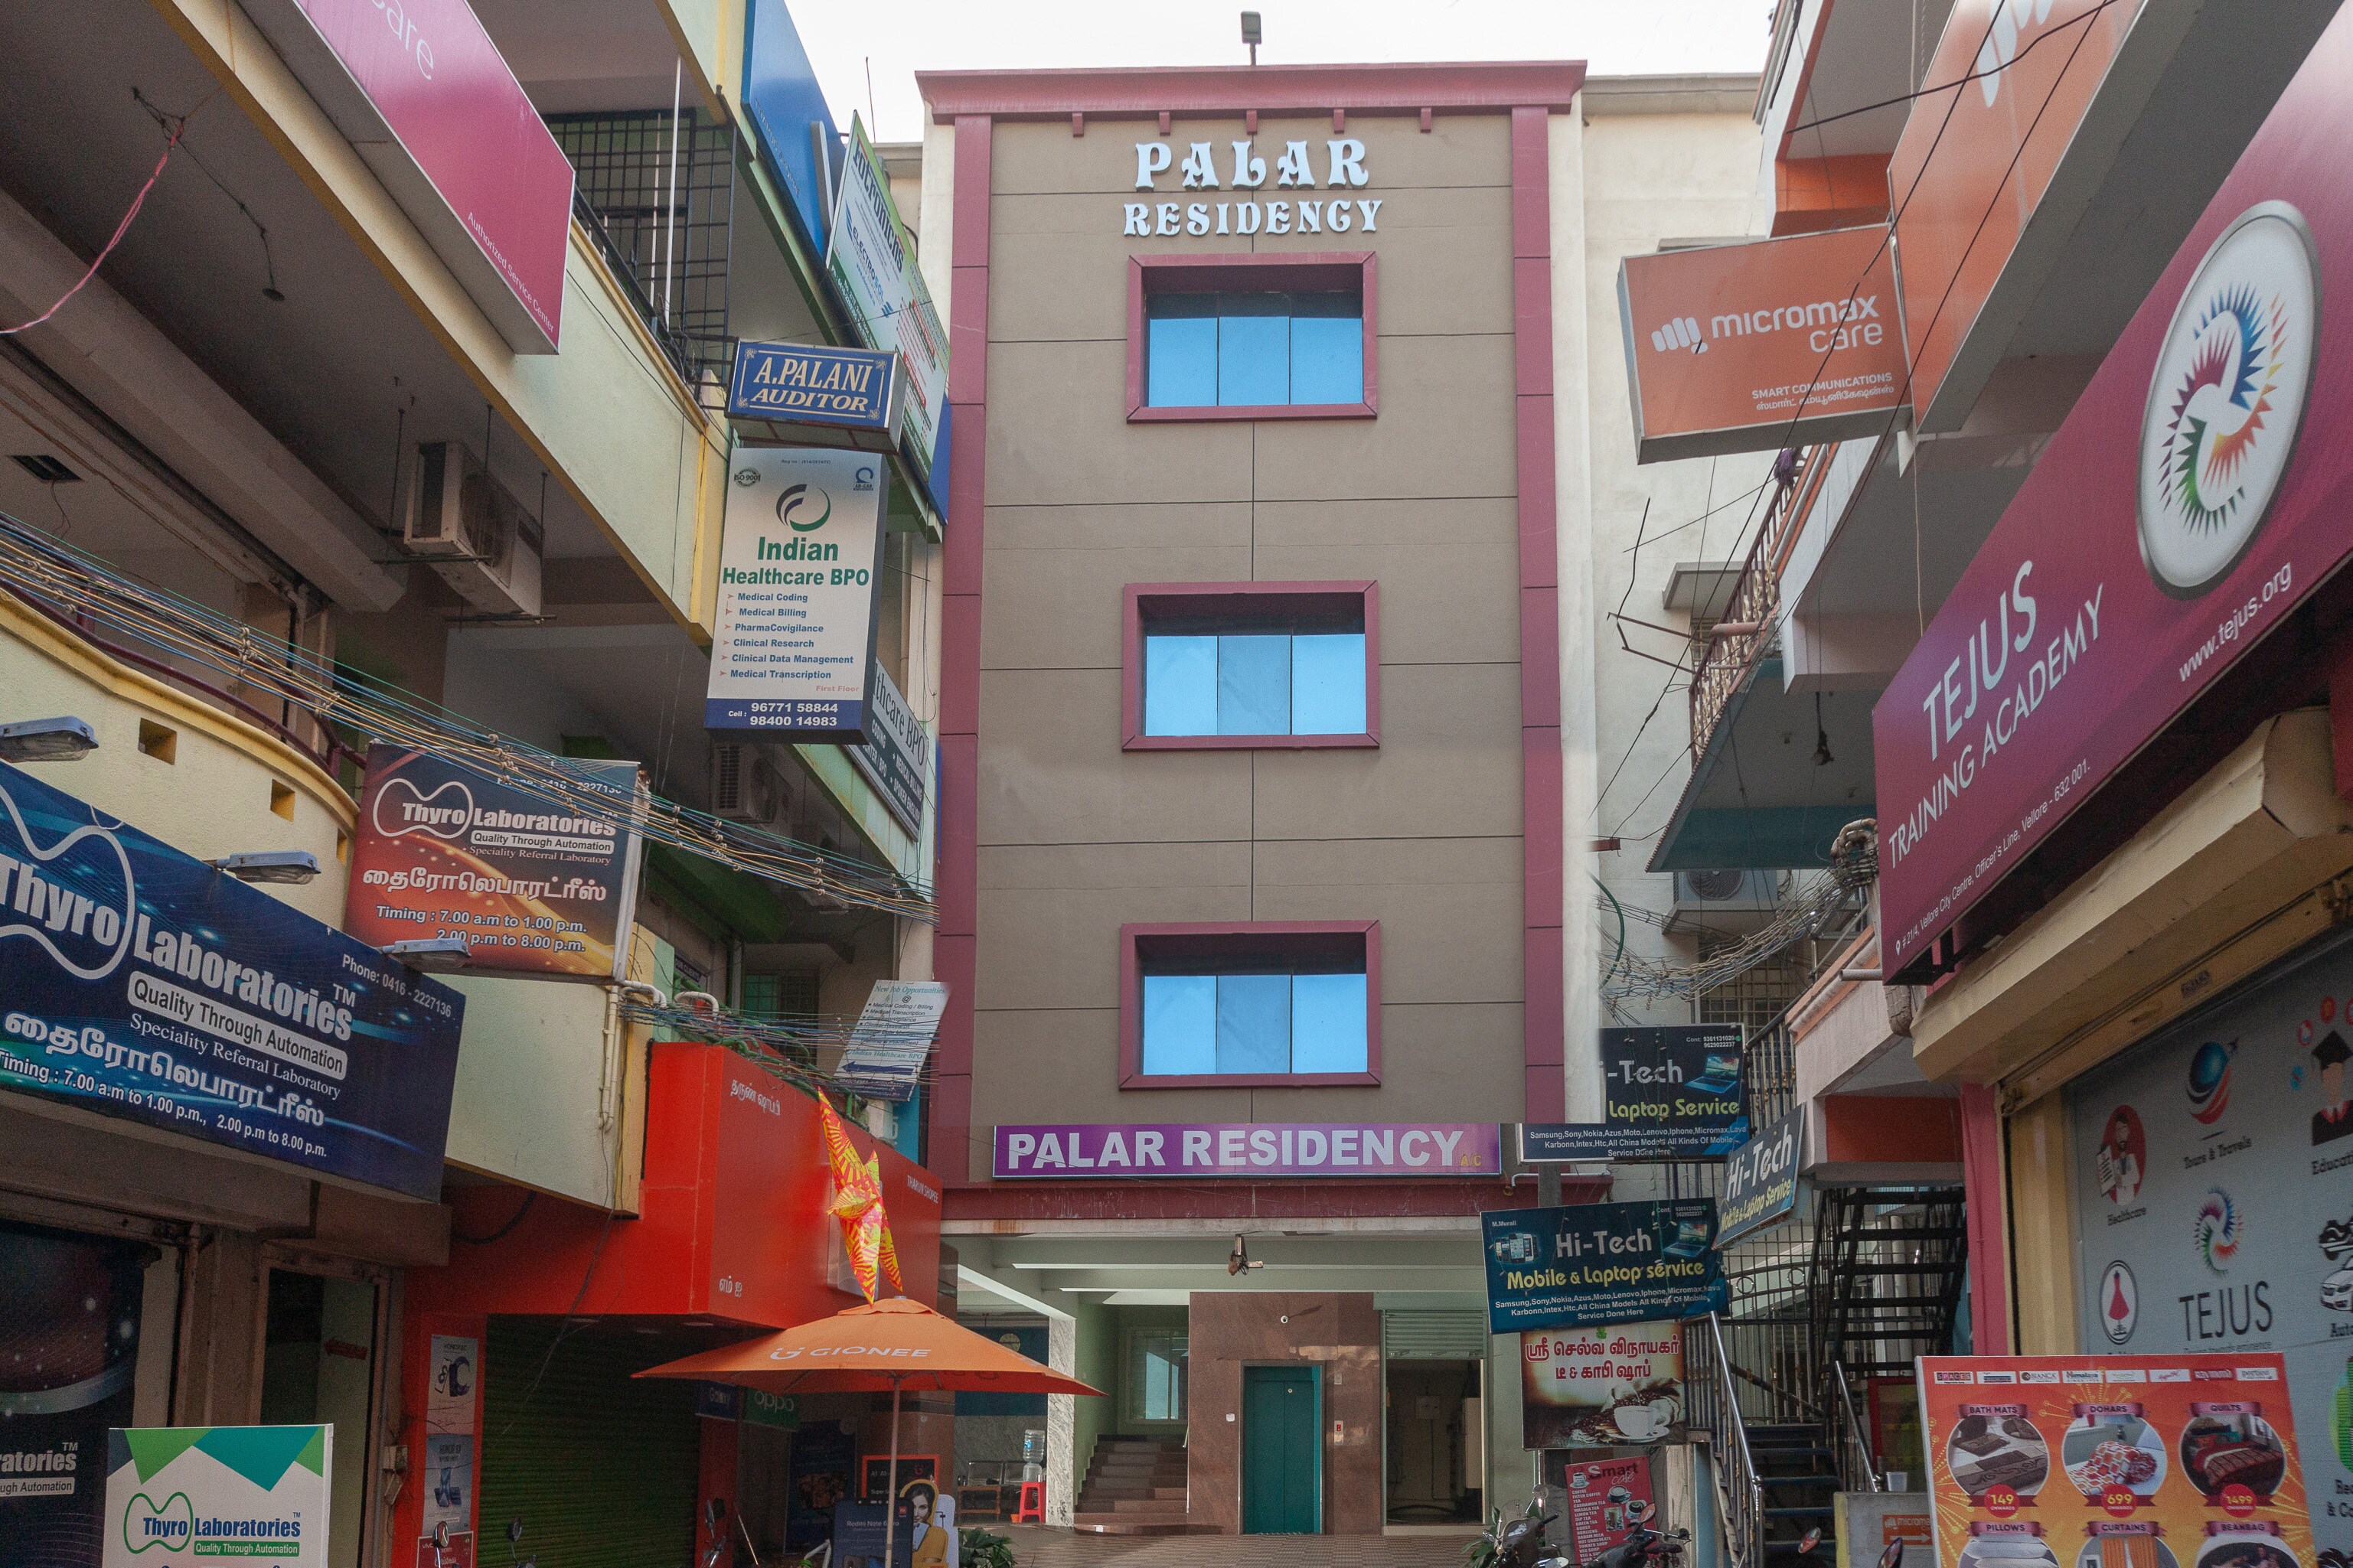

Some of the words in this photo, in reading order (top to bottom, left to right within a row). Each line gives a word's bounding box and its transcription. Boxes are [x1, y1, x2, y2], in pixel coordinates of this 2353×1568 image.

[1135, 139, 1369, 190] PALAR
[1124, 200, 1382, 236] RESIDENCY
[468, 212, 507, 268] Authorized
[507, 265, 532, 303] Service
[533, 299, 554, 333] Center
[1712, 295, 1879, 339] micromax
[1810, 322, 1883, 353] care
[754, 357, 873, 393] A.PALANI
[1751, 386, 1789, 399] SMART
[1792, 373, 1892, 394] COMMUNICATIONS
[751, 388, 868, 412] AUDITOR
[758, 536, 838, 561] Indian
[723, 568, 824, 585] Healthcare
[831, 569, 869, 585] BPO
[738, 592, 773, 601] Medical
[776, 593, 808, 603] Coding
[739, 608, 775, 616] Medical
[778, 608, 807, 618] Billing
[2179, 562, 2292, 682] www.tejus.org
[735, 623, 824, 634] PharmaCovigilance
[733, 639, 769, 647] Clinical
[771, 639, 814, 647] Research
[732, 654, 766, 663] Clinical
[769, 654, 791, 663] Data
[794, 655, 853, 665] Management
[1923, 560, 2037, 761] TEJUS
[730, 670, 766, 678] Medical
[769, 670, 831, 680] Transcription
[751, 703, 791, 712] 96771
[797, 703, 838, 712] 58844
[750, 716, 791, 726] 98400
[796, 717, 837, 726] 14983
[1889, 745, 1975, 869] TRAINING
[1982, 582, 2103, 768] ACADEMY
[906, 715, 925, 766] BPO
[403, 803, 466, 826] Thyro
[474, 808, 616, 836] Laboratories
[475, 833, 509, 847] Quality
[511, 835, 553, 848] Through
[554, 839, 611, 851] Automation
[1921, 907, 1939, 930] Vellore
[1940, 895, 1951, 911] City
[1952, 875, 1974, 900] Centre,
[1975, 846, 2002, 879] Officer's
[2003, 829, 2020, 852] Line,
[2022, 800, 2048, 832] Vellore
[2054, 776, 2070, 802] 632
[469, 846, 517, 859] Speciality
[519, 849, 557, 861] Referral
[560, 852, 612, 865] Laboratory
[377, 905, 426, 923] Timing
[440, 910, 470, 924] 7.00
[474, 914, 500, 925] a.m
[504, 914, 518, 927] to
[524, 915, 553, 929] 1.00
[556, 920, 587, 934] p.m.
[471, 934, 498, 947] p.m
[501, 933, 517, 946] to
[521, 935, 550, 948] 8.00
[553, 939, 586, 953] p.m.
[134, 914, 353, 1042] Laboratories
[342, 954, 380, 984] Phone:
[383, 973, 406, 996] 0416
[413, 988, 452, 1017] 2227136
[333, 983, 356, 1007] TM
[901, 986, 945, 995] Opportunities
[134, 978, 194, 1022] Quality
[200, 1001, 262, 1045] Through
[266, 1028, 342, 1074] Automation
[130, 1012, 208, 1055] Speciality
[213, 1045, 269, 1074] Referral
[273, 1061, 341, 1100] Laboratory
[64, 1069, 95, 1092] 7.00
[98, 1084, 124, 1101] a.m
[129, 1090, 142, 1105] to
[147, 1094, 173, 1114] 1.00
[217, 1113, 242, 1133] 2.00
[244, 1122, 266, 1141] p.m
[269, 1127, 279, 1144] to
[282, 1132, 303, 1151] 8.00
[305, 1139, 327, 1158] p.m.
[1609, 1100, 1670, 1123] Laptop
[1676, 1097, 1739, 1116] Service
[1008, 1131, 1164, 1169] PALAR
[1183, 1130, 1463, 1167] RESIDENCY
[1619, 1138, 1639, 1146] China
[1678, 1136, 1699, 1145] Kinds
[1700, 1136, 1708, 1144] Of
[1607, 1148, 1634, 1157] Service
[1727, 1123, 1793, 1202] Hi-Tech
[1765, 1177, 1791, 1208] Service
[1556, 1228, 1652, 1259] Hi-Tech
[1507, 1269, 1566, 1289] Mobile
[1570, 1273, 1580, 1285] &
[1584, 1266, 1641, 1286] Laptop
[1647, 1259, 1705, 1278] service
[1578, 1310, 1604, 1320] Service
[1606, 1309, 1625, 1319] Done
[1627, 1308, 1643, 1317] Here
[1590, 1302, 1610, 1311] China
[1611, 1299, 1638, 1309] Models
[2179, 1280, 2273, 1341] TEJUS
[809, 1345, 932, 1358] GIONEE
[1554, 1337, 1605, 1356] செல்வ
[1610, 1335, 1679, 1358] விநாயகர்
[1581, 1359, 1614, 1378] காபி
[1617, 1359, 1651, 1381] ஷாப்
[1937, 1372, 1972, 1381] SPACES
[2090, 1405, 2127, 1413] DOHARS
[62, 1441, 79, 1452] TM
[21, 1481, 72, 1493] Automation
[1991, 1494, 2015, 1505] 149
[2107, 1493, 2133, 1504] 699
[2226, 1495, 2252, 1504] 1499
[143, 1517, 188, 1537] Thyro
[194, 1517, 301, 1537] Laboratories
[1986, 1524, 2025, 1532] PILLOWS
[2101, 1524, 2146, 1532] CURTAINS
[196, 1543, 221, 1555] Quality
[223, 1543, 253, 1555] Through
[255, 1544, 298, 1554] Automation
